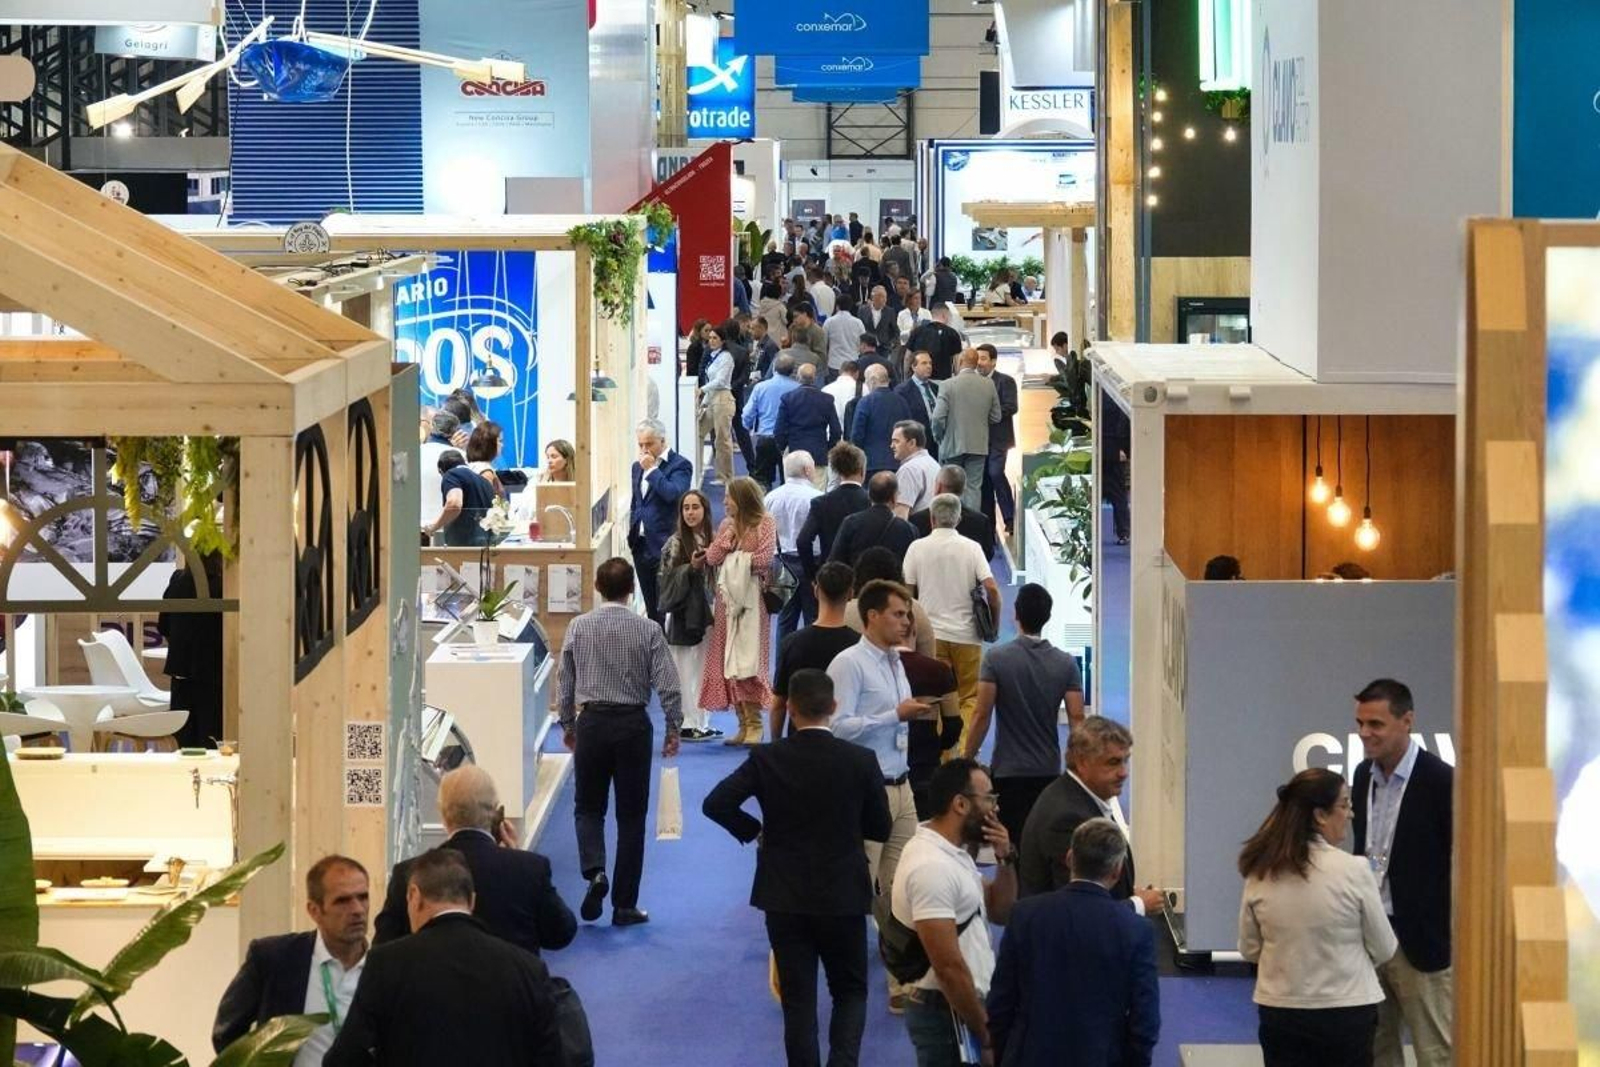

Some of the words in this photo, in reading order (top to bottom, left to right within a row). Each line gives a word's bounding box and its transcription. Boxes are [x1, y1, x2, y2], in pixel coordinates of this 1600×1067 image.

[796, 23, 853, 32] conxemar
[124, 39, 168, 51] Gelagri
[820, 64, 864, 72] conxemar
[1009, 92, 1085, 111] KESSLER
[687, 106, 751, 129] otrade
[396, 276, 449, 306] ARIO
